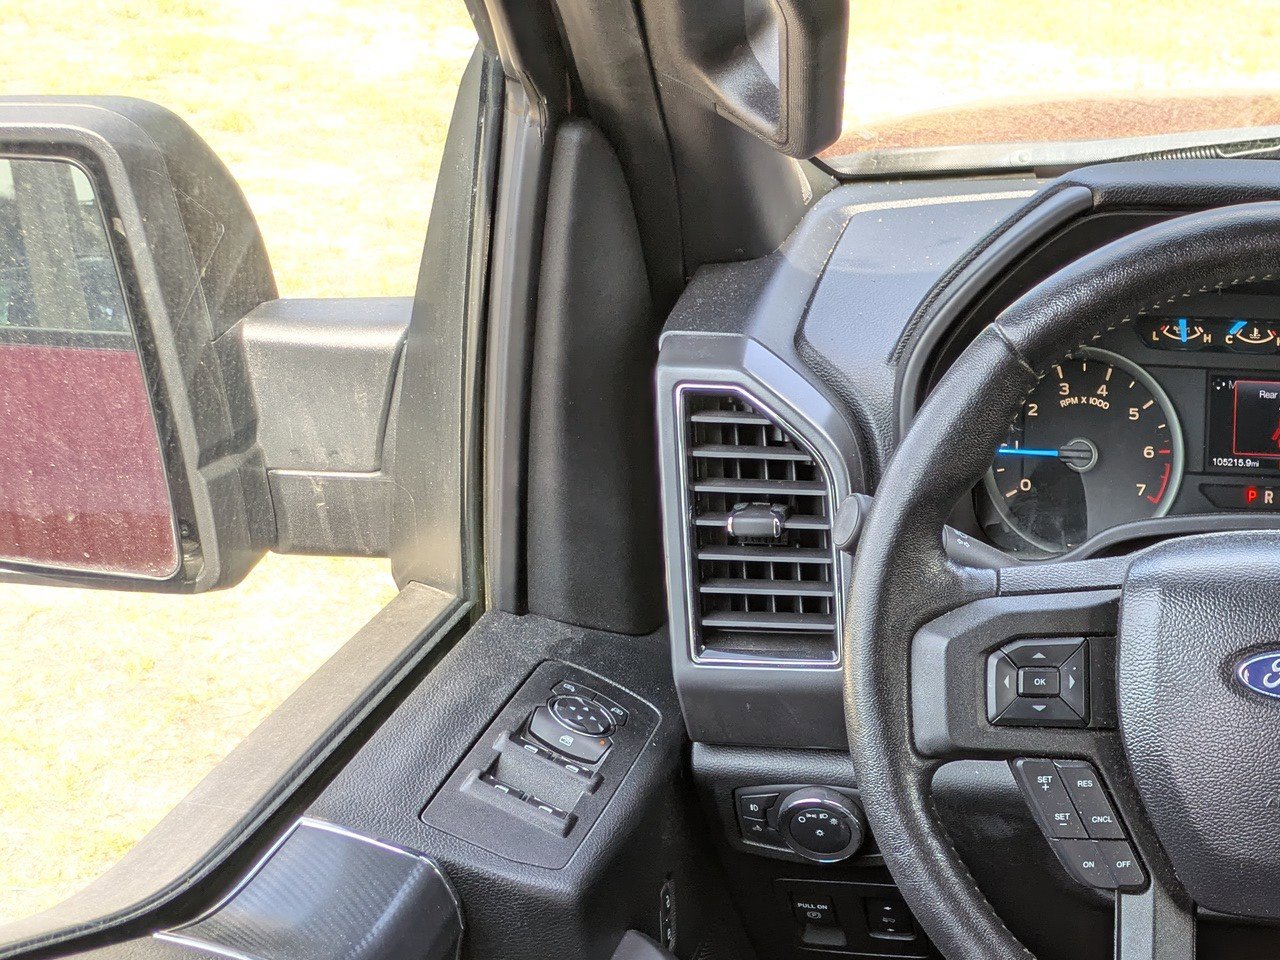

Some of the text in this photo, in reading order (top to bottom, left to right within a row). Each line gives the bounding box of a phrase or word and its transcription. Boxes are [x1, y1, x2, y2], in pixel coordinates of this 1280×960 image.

[1152, 331, 1159, 341] L
[1204, 334, 1211, 343] H
[1225, 335, 1233, 344] C
[1059, 383, 1070, 396] 3
[1097, 384, 1108, 397] 4
[1259, 390, 1278, 399] Rear
[1060, 396, 1110, 410] RPM X 1000
[1028, 404, 1038, 416] 2
[1128, 408, 1140, 421] 5
[1143, 446, 1155, 458] 6
[1020, 478, 1032, 491] 0
[1136, 484, 1146, 496] 7
[1248, 489, 1257, 502] P
[1264, 490, 1274, 504] R
[1034, 678, 1046, 686] OK
[1038, 776, 1052, 784] SET
[1078, 780, 1093, 788] RES
[1054, 812, 1070, 821] SET
[1092, 816, 1112, 824] CNCL
[1116, 860, 1131, 868] OFF
